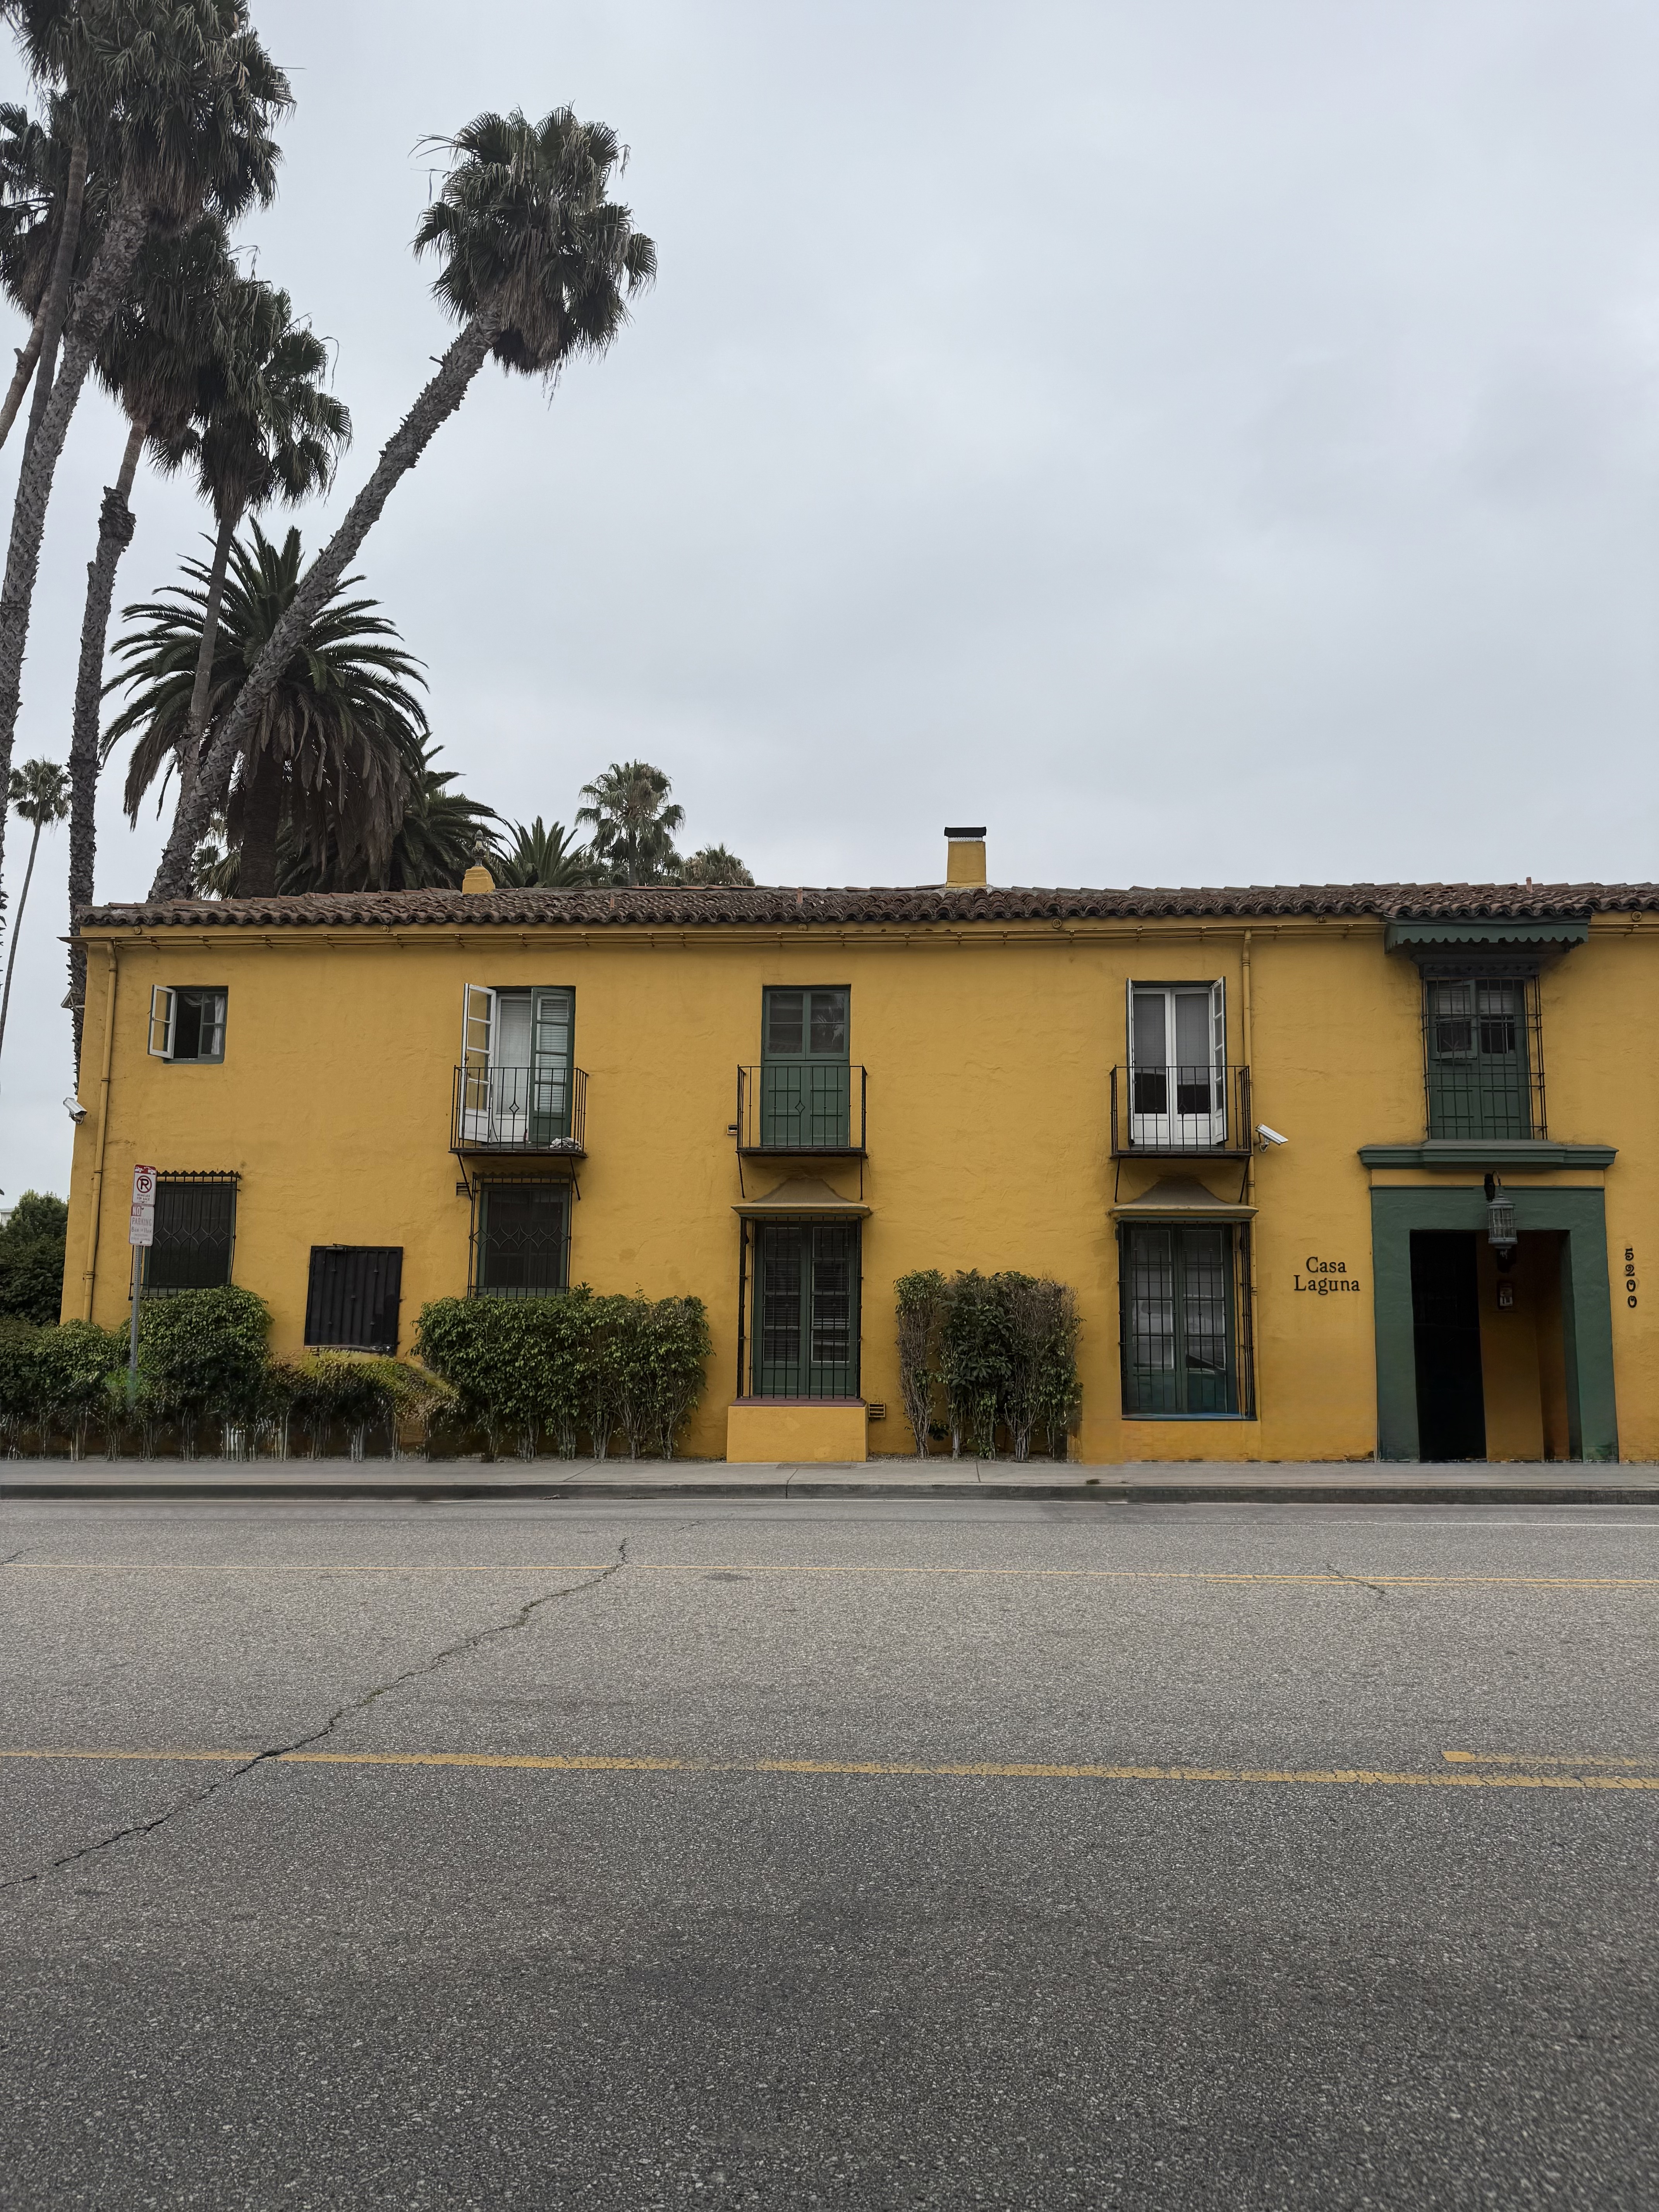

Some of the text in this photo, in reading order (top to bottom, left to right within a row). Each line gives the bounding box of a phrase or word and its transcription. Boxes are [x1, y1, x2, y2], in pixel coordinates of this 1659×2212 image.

[132, 1207, 141, 1215] NO
[132, 1218, 151, 1226] PARKING
[1306, 1257, 1346, 1273] Casa
[1293, 1275, 1360, 1295] Laguna
[1625, 1248, 1637, 1308] 5200
